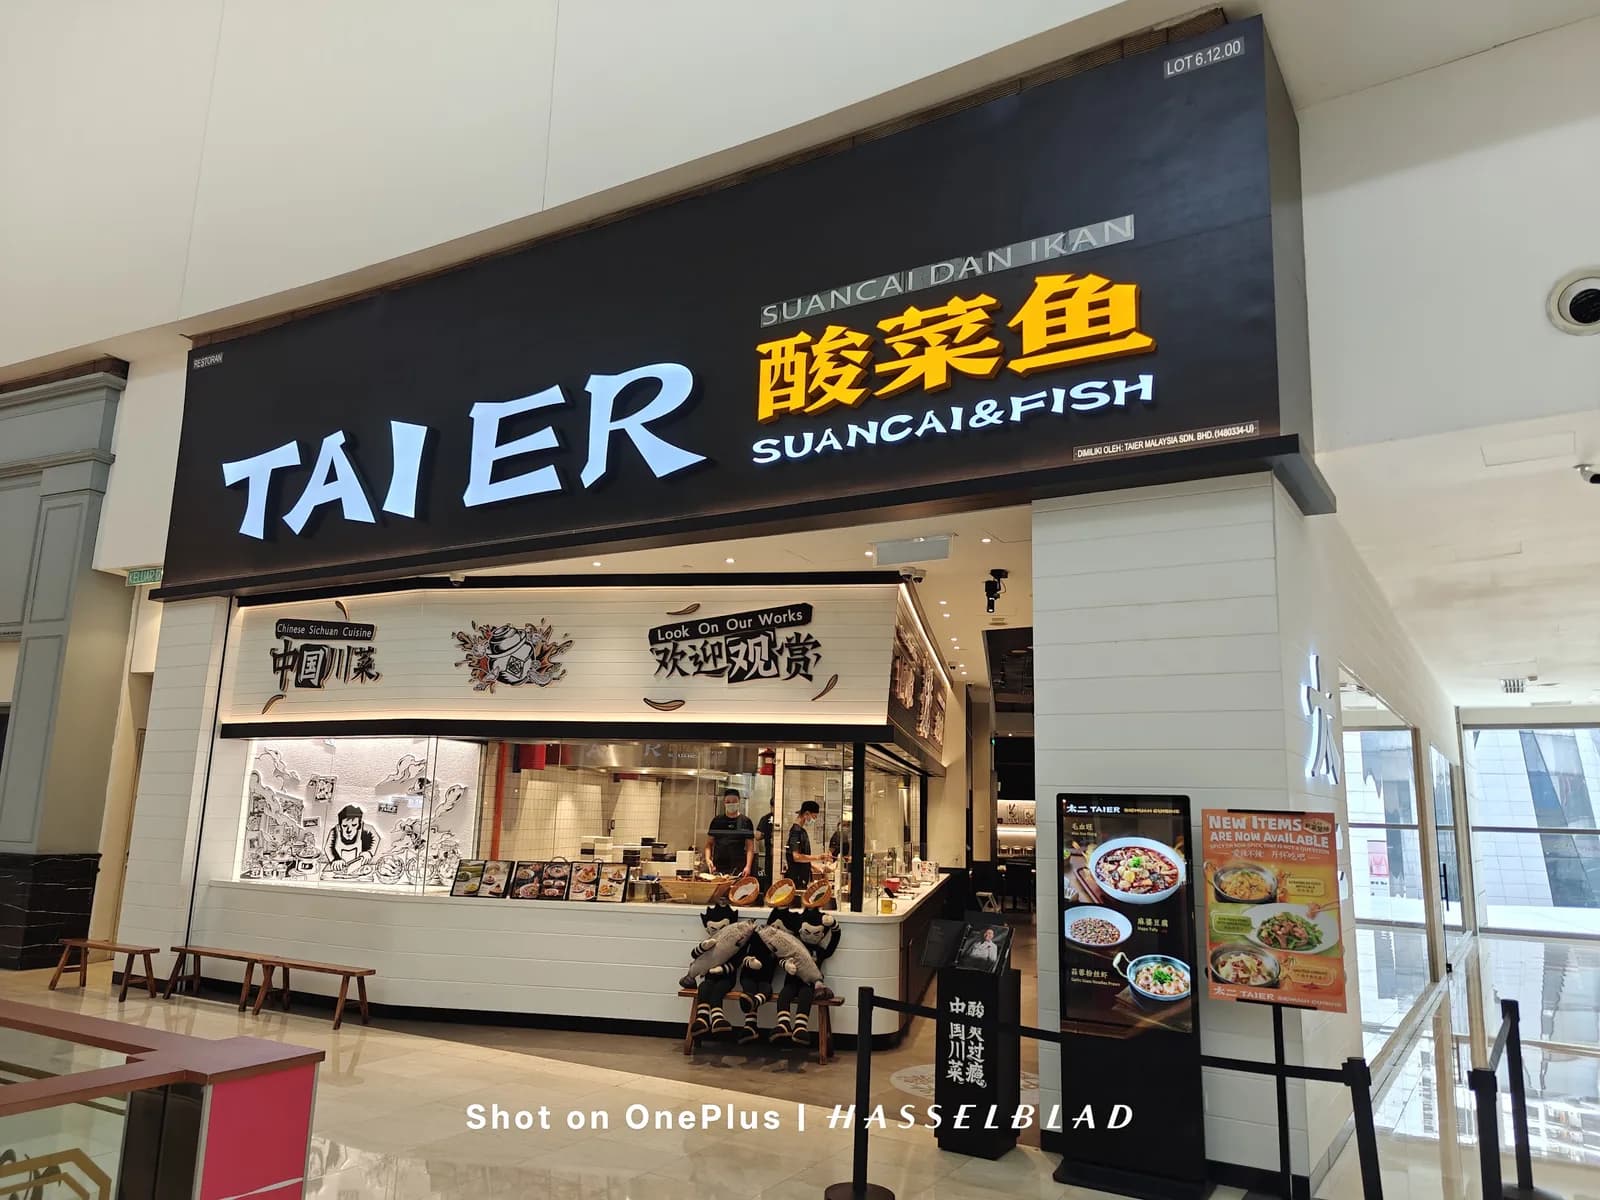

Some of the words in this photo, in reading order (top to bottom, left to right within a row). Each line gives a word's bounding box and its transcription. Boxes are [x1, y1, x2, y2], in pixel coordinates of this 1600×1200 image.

[1167, 54, 1193, 75] LOT
[1195, 40, 1241, 66] 6.12.00
[761, 271, 915, 327] SUANCAI
[930, 250, 1013, 286] DAN
[1030, 214, 1133, 261] IKAN
[193, 352, 224, 369] RESTORAN
[755, 272, 1157, 424] 酸菜鱼
[751, 373, 1155, 466] SUANCAI&FISH
[222, 362, 707, 540] TAIER
[1077, 447, 1103, 458] DIMILIKI
[1103, 444, 1124, 455] OLEH:
[1124, 440, 1144, 452] TAIER
[1144, 436, 1179, 449] MALAYSIA
[1178, 433, 1195, 444] SDN.
[1196, 430, 1213, 442] BHD.
[276, 623, 306, 635] Chinese
[308, 625, 339, 636] Sichuan
[342, 626, 372, 638] Cuisine
[657, 625, 690, 641] Look
[698, 622, 719, 635] On
[726, 618, 753, 631] Our
[758, 609, 803, 626] Works
[270, 639, 382, 691] 中国川菜
[650, 630, 822, 683] 欢迎观赏
[1066, 804, 1089, 814] 太二
[1090, 806, 1121, 814] TAIER
[1208, 815, 1246, 829] NEW
[1251, 816, 1302, 832] ITEMS
[1210, 831, 1232, 842] ARE
[1137, 917, 1168, 928] 麻婆豆腐
[1240, 990, 1274, 1001] TAIER
